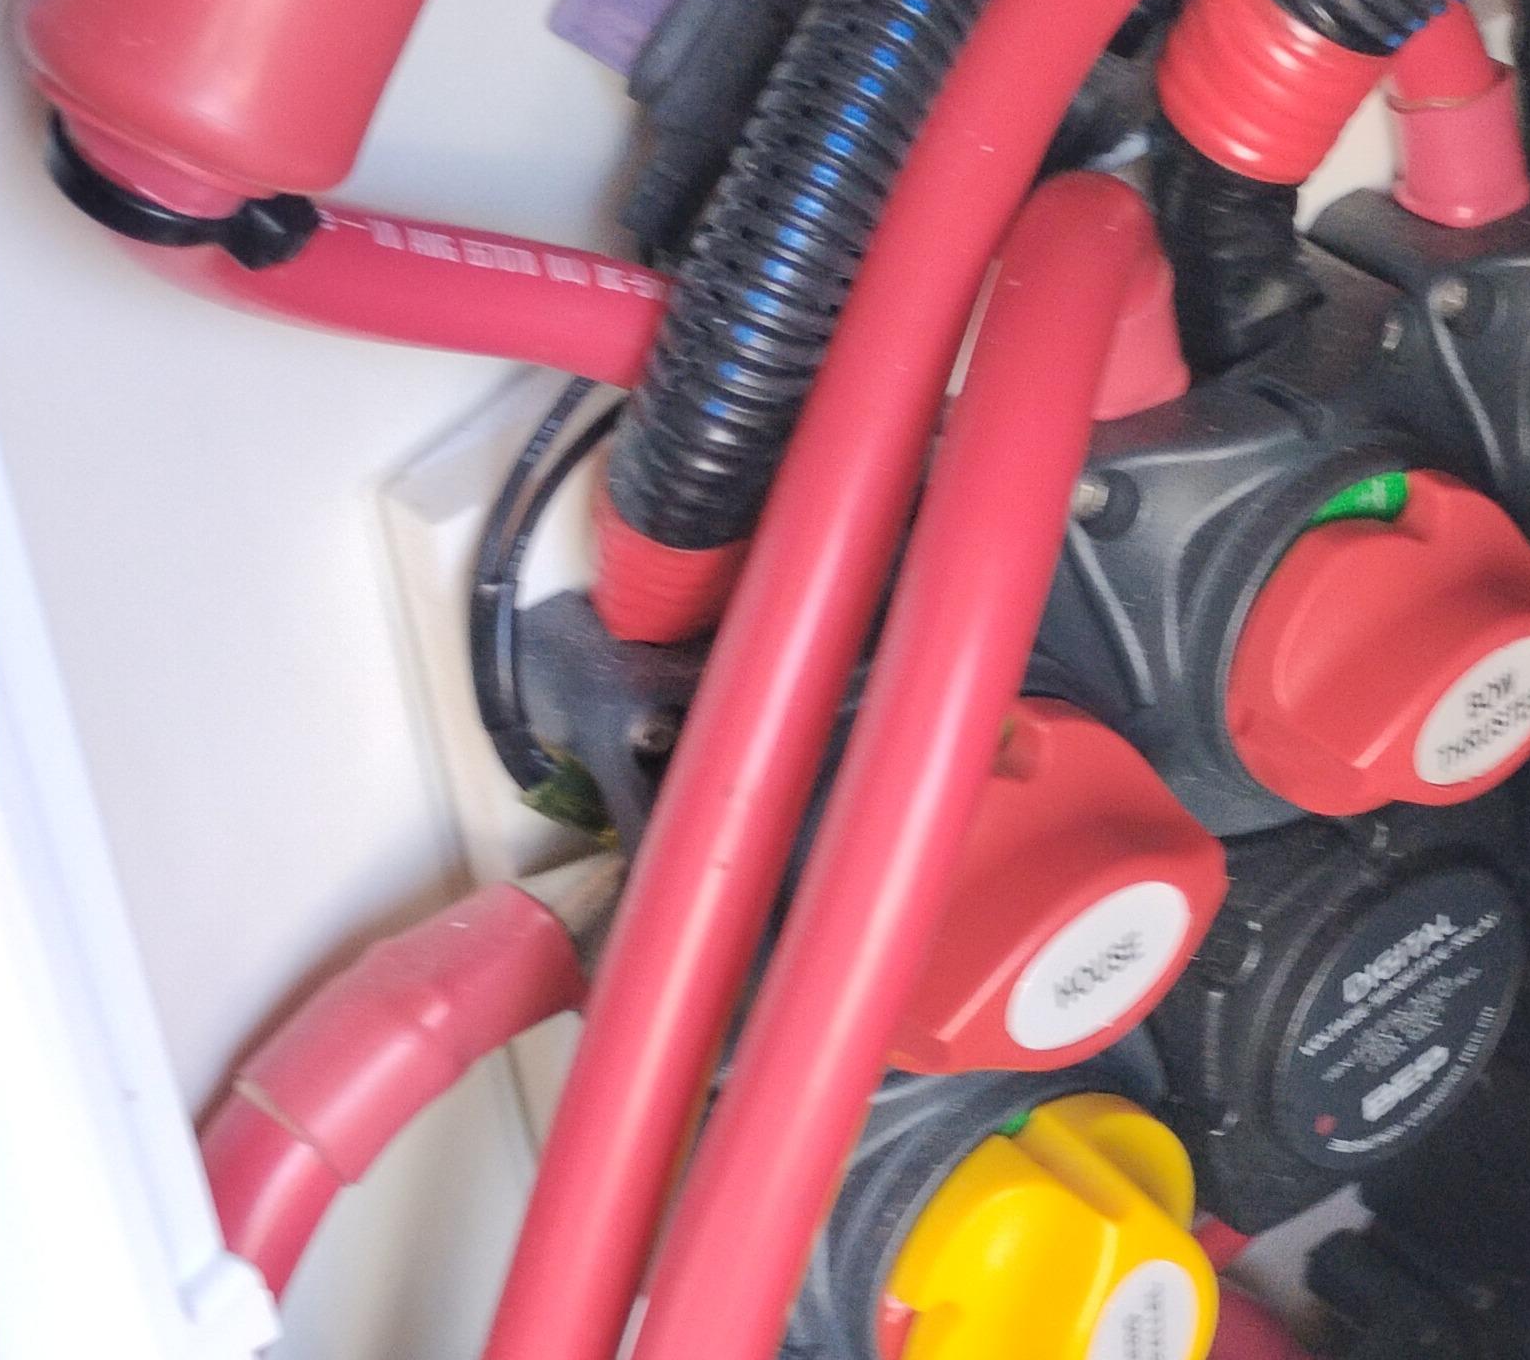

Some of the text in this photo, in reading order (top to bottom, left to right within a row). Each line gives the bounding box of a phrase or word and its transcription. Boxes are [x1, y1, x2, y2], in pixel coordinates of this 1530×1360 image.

[1465, 670, 1516, 717] BOW
[1053, 930, 1144, 1011] HOUSE
[1341, 913, 1460, 1004] DIGITAL
